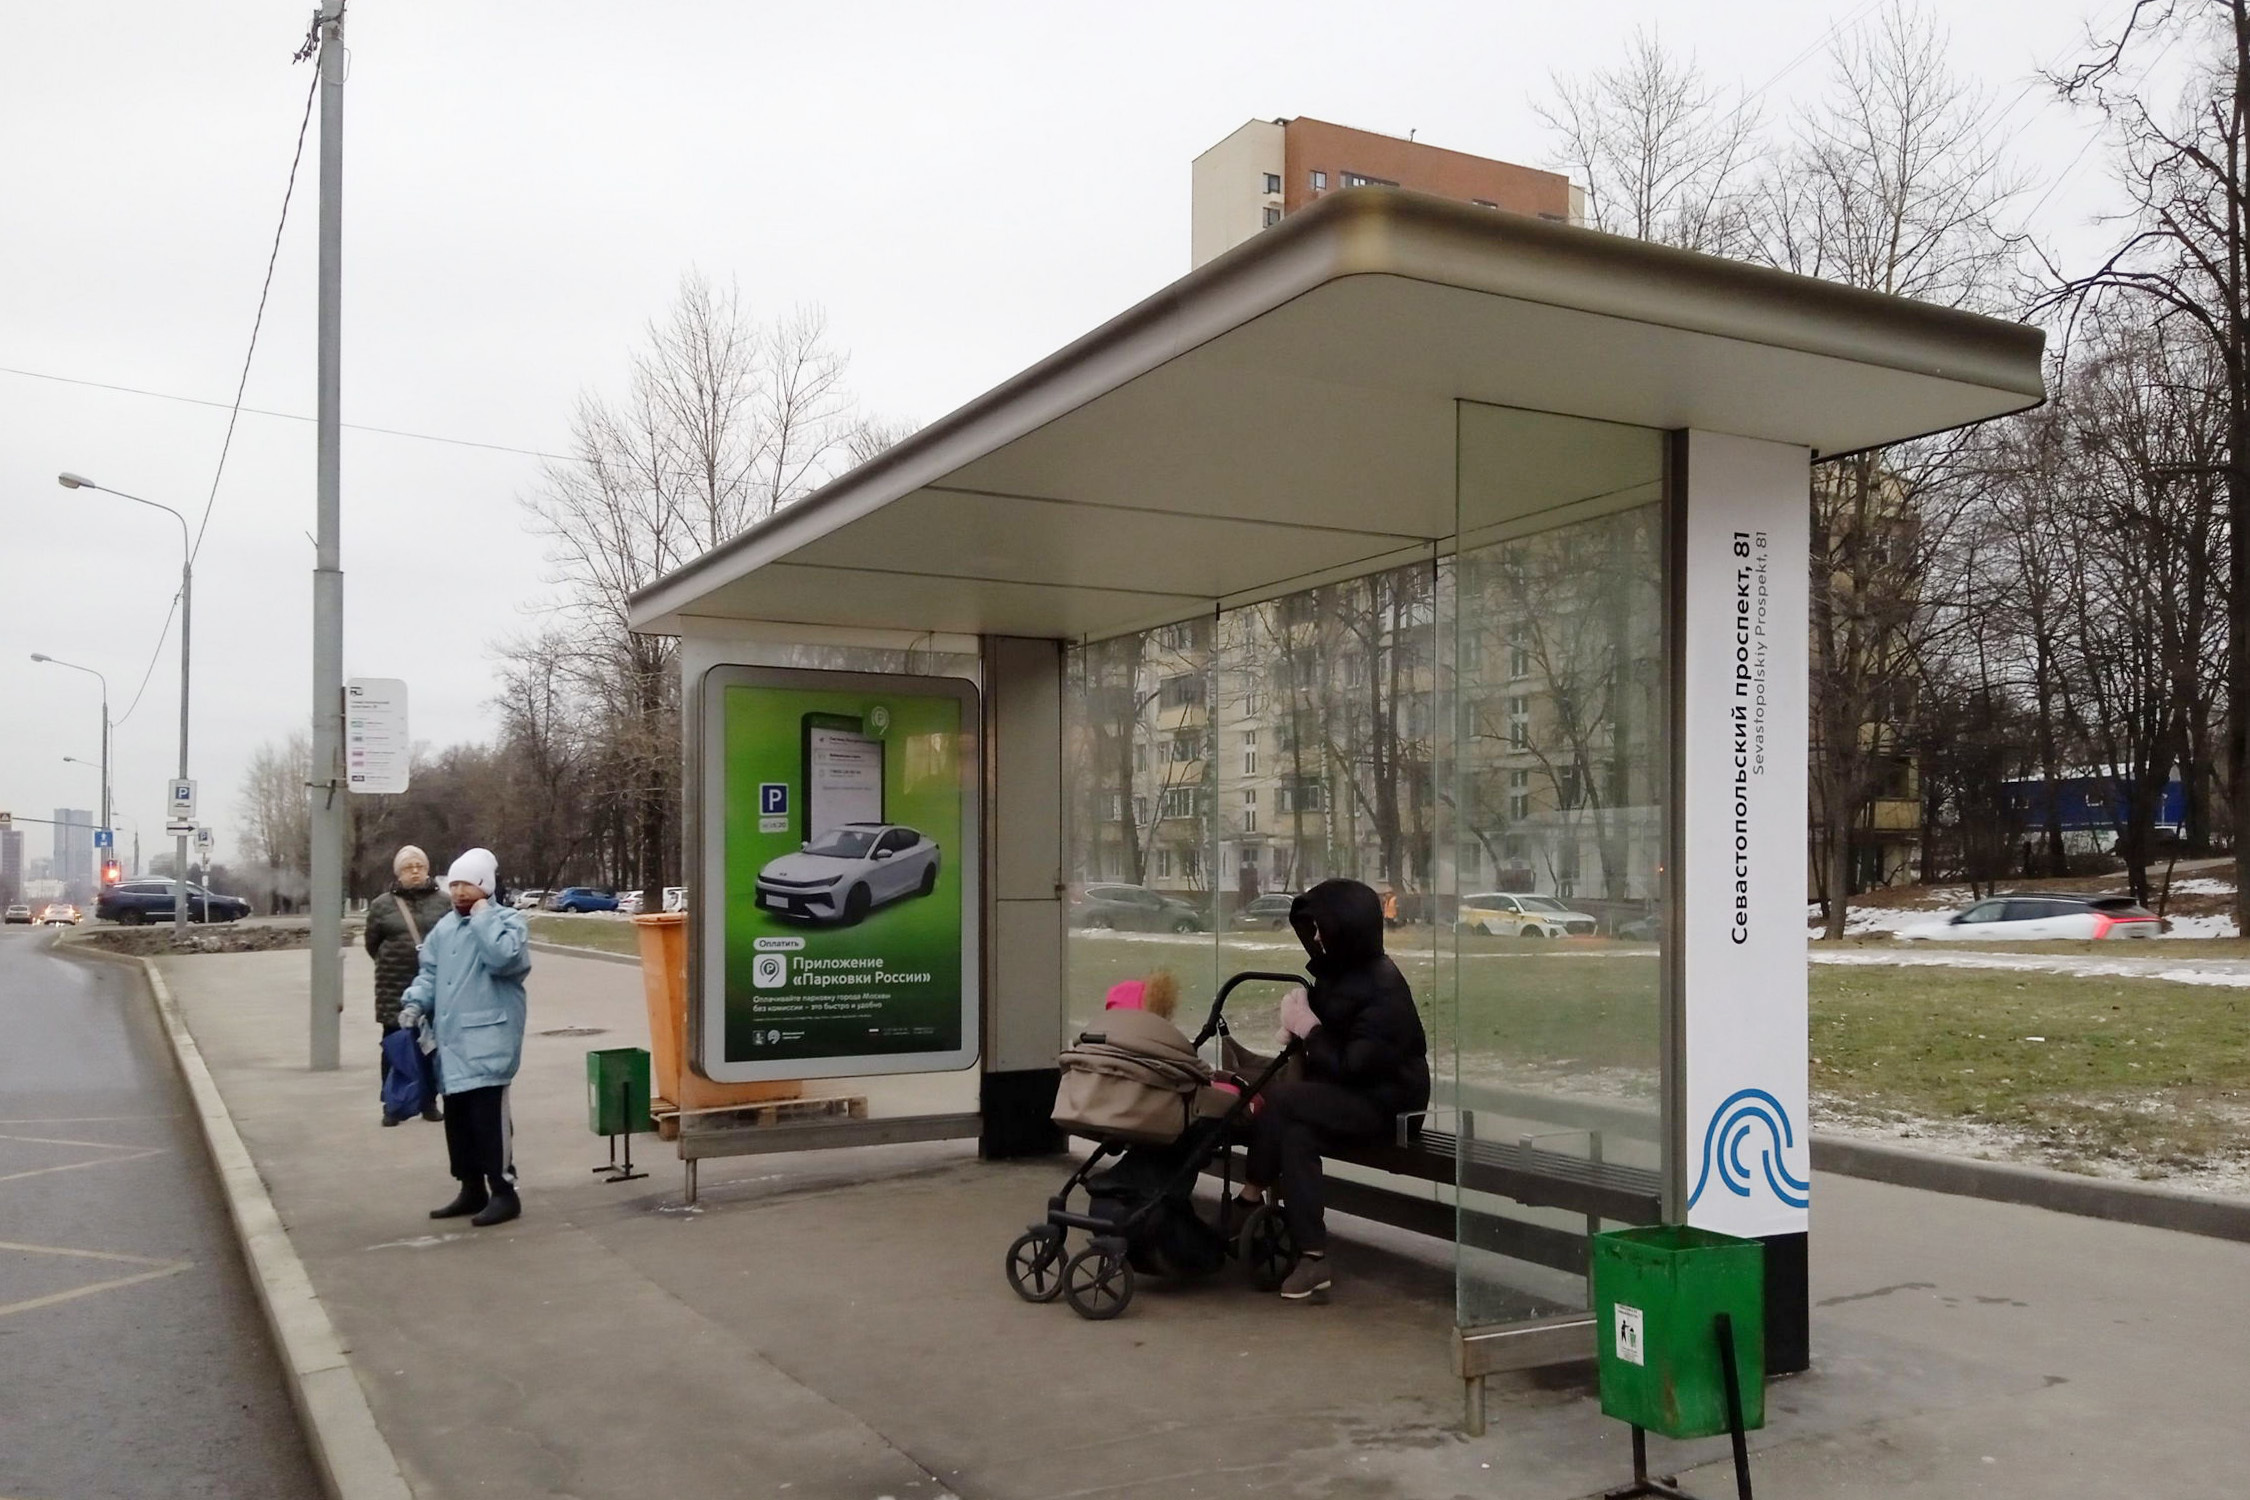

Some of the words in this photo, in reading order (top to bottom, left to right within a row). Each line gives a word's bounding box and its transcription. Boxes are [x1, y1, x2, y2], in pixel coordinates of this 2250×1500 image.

[1733, 531, 1750, 558] 81
[1755, 531, 1767, 549] 81
[1755, 553, 1768, 636] Prospekt,
[1736, 566, 1752, 697] проспект,
[1753, 642, 1767, 775] Sevastopolskiy
[178, 788, 188, 799] P
[768, 789, 782, 811] P
[1731, 706, 1748, 945] Севастопольский
[759, 940, 799, 948] Оплатить
[793, 957, 884, 971] Приложение
[793, 972, 872, 987] «Парковки
[875, 971, 931, 984] России»
[824, 1003, 850, 1011] быстро
[857, 1001, 883, 1010] удобно
